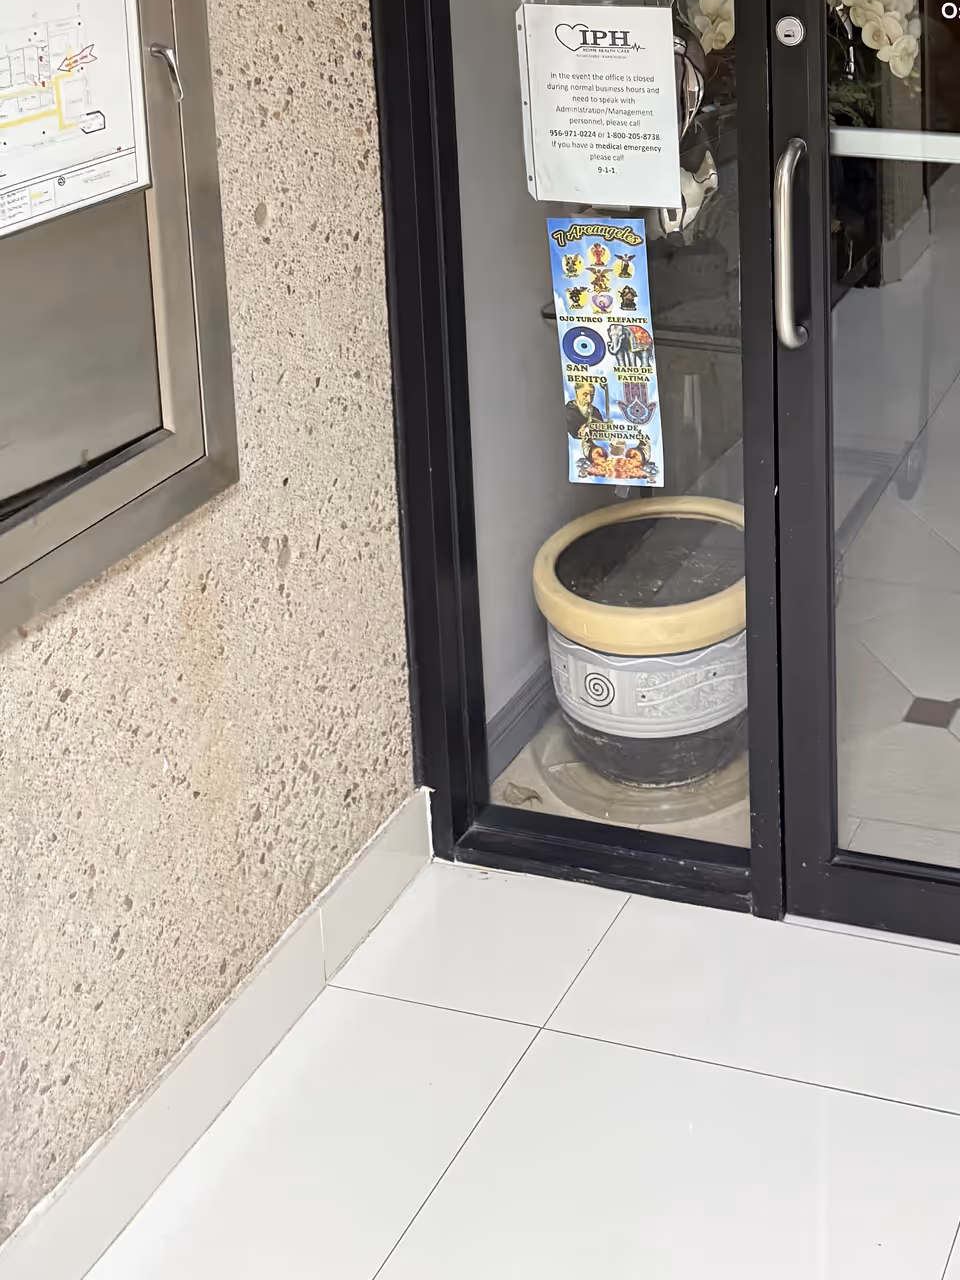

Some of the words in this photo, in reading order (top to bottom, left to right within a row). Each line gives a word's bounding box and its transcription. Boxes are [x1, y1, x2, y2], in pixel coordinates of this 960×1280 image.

[579, 29, 631, 46] IPH
[558, 72, 571, 80] the
[592, 73, 604, 81] the
[633, 75, 655, 83] closed
[547, 83, 569, 91] during
[595, 84, 624, 93] business
[599, 96, 619, 105] speak
[555, 106, 654, 117] Administration/Management
[569, 118, 605, 126] personnel,
[605, 119, 628, 127] please
[549, 129, 597, 137] 956-971-0224
[571, 141, 589, 149] have
[589, 153, 612, 161] please
[552, 229, 566, 247] 7
[565, 223, 644, 246] Arcangeles
[607, 316, 648, 324] ELEFANTE
[566, 364, 588, 372] SAN
[567, 374, 608, 384] BENITO
[589, 423, 625, 431] CUERNO
[592, 431, 651, 441] ABUNDANCIA
